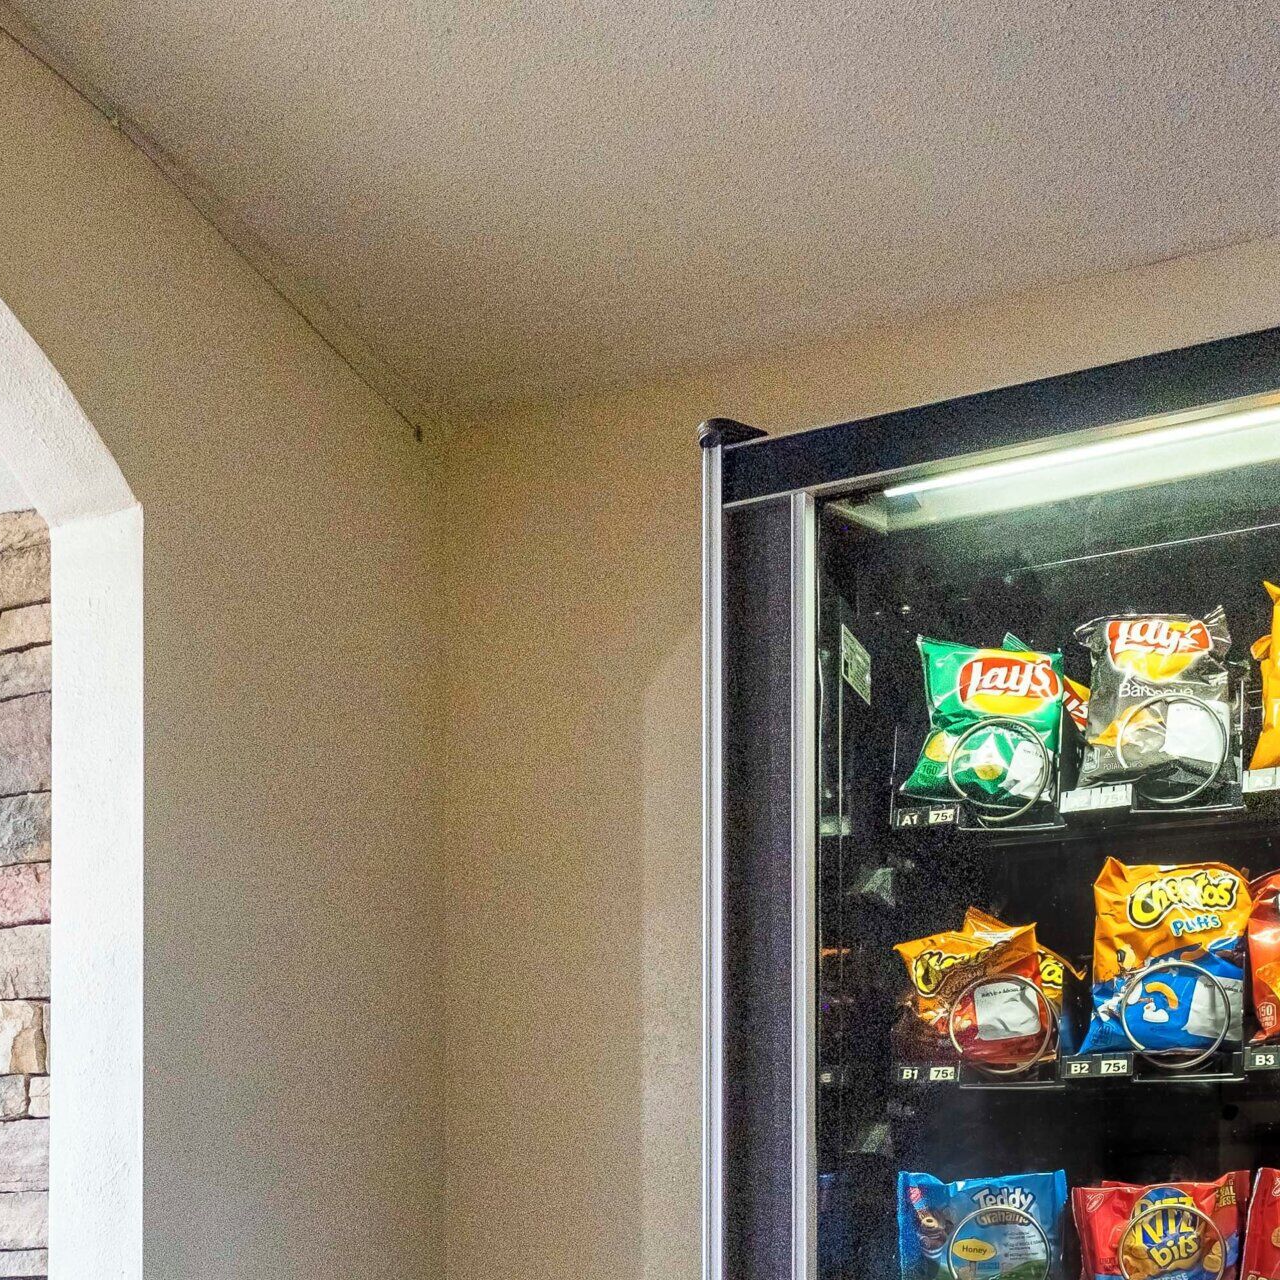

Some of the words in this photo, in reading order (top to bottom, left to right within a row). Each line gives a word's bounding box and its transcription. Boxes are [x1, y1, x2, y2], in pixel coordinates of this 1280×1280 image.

[901, 813, 918, 825] A1
[1131, 873, 1235, 924] Cheetos
[1255, 1054, 1274, 1066] B3
[902, 1068, 918, 1080] B1
[1070, 1063, 1089, 1074] B2
[973, 1187, 1034, 1211] Teddy
[1134, 1197, 1197, 1247] RITZ
[962, 1244, 988, 1256] Honey
[1149, 1235, 1199, 1268] bits
